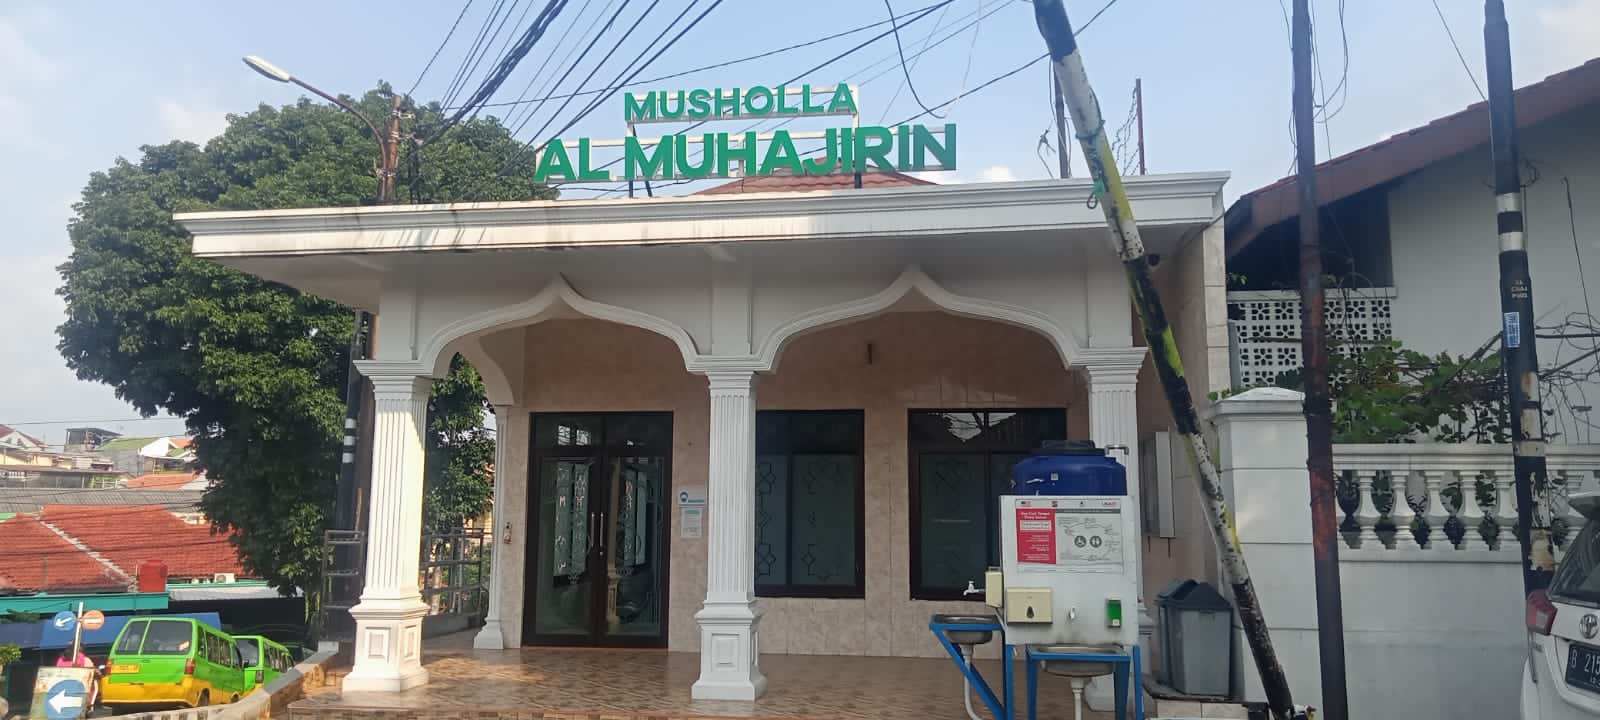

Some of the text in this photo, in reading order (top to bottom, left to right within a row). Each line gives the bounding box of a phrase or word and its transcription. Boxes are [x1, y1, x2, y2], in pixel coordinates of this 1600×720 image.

[624, 83, 858, 121] MUSHOLLA
[534, 123, 957, 183] AL MUHAJIRIN
